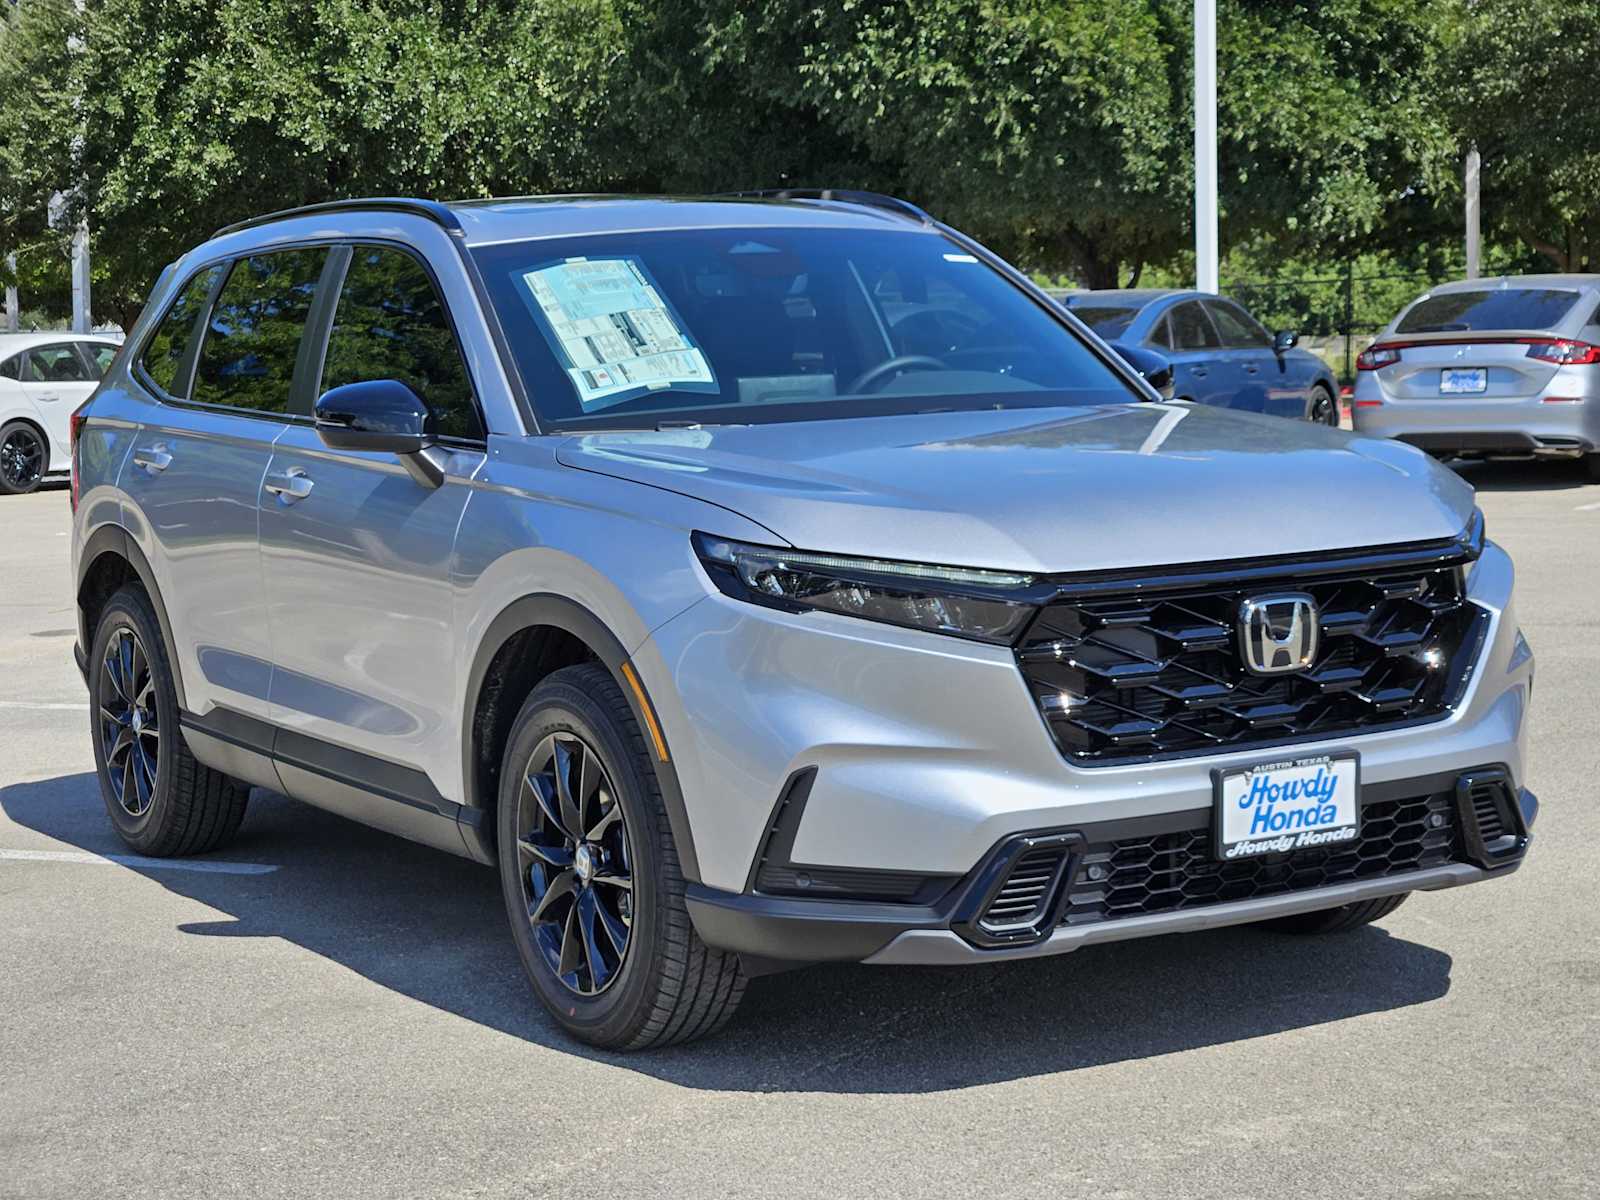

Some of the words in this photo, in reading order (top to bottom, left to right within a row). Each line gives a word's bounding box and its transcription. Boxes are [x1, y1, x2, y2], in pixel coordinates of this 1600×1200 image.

[1253, 761, 1293, 773] AUSTIN
[1296, 756, 1330, 767] TEXAS
[1239, 768, 1338, 809] Howdy
[1250, 804, 1337, 835] Honda
[1226, 834, 1296, 857] Howdy
[1296, 827, 1356, 846] Honda
